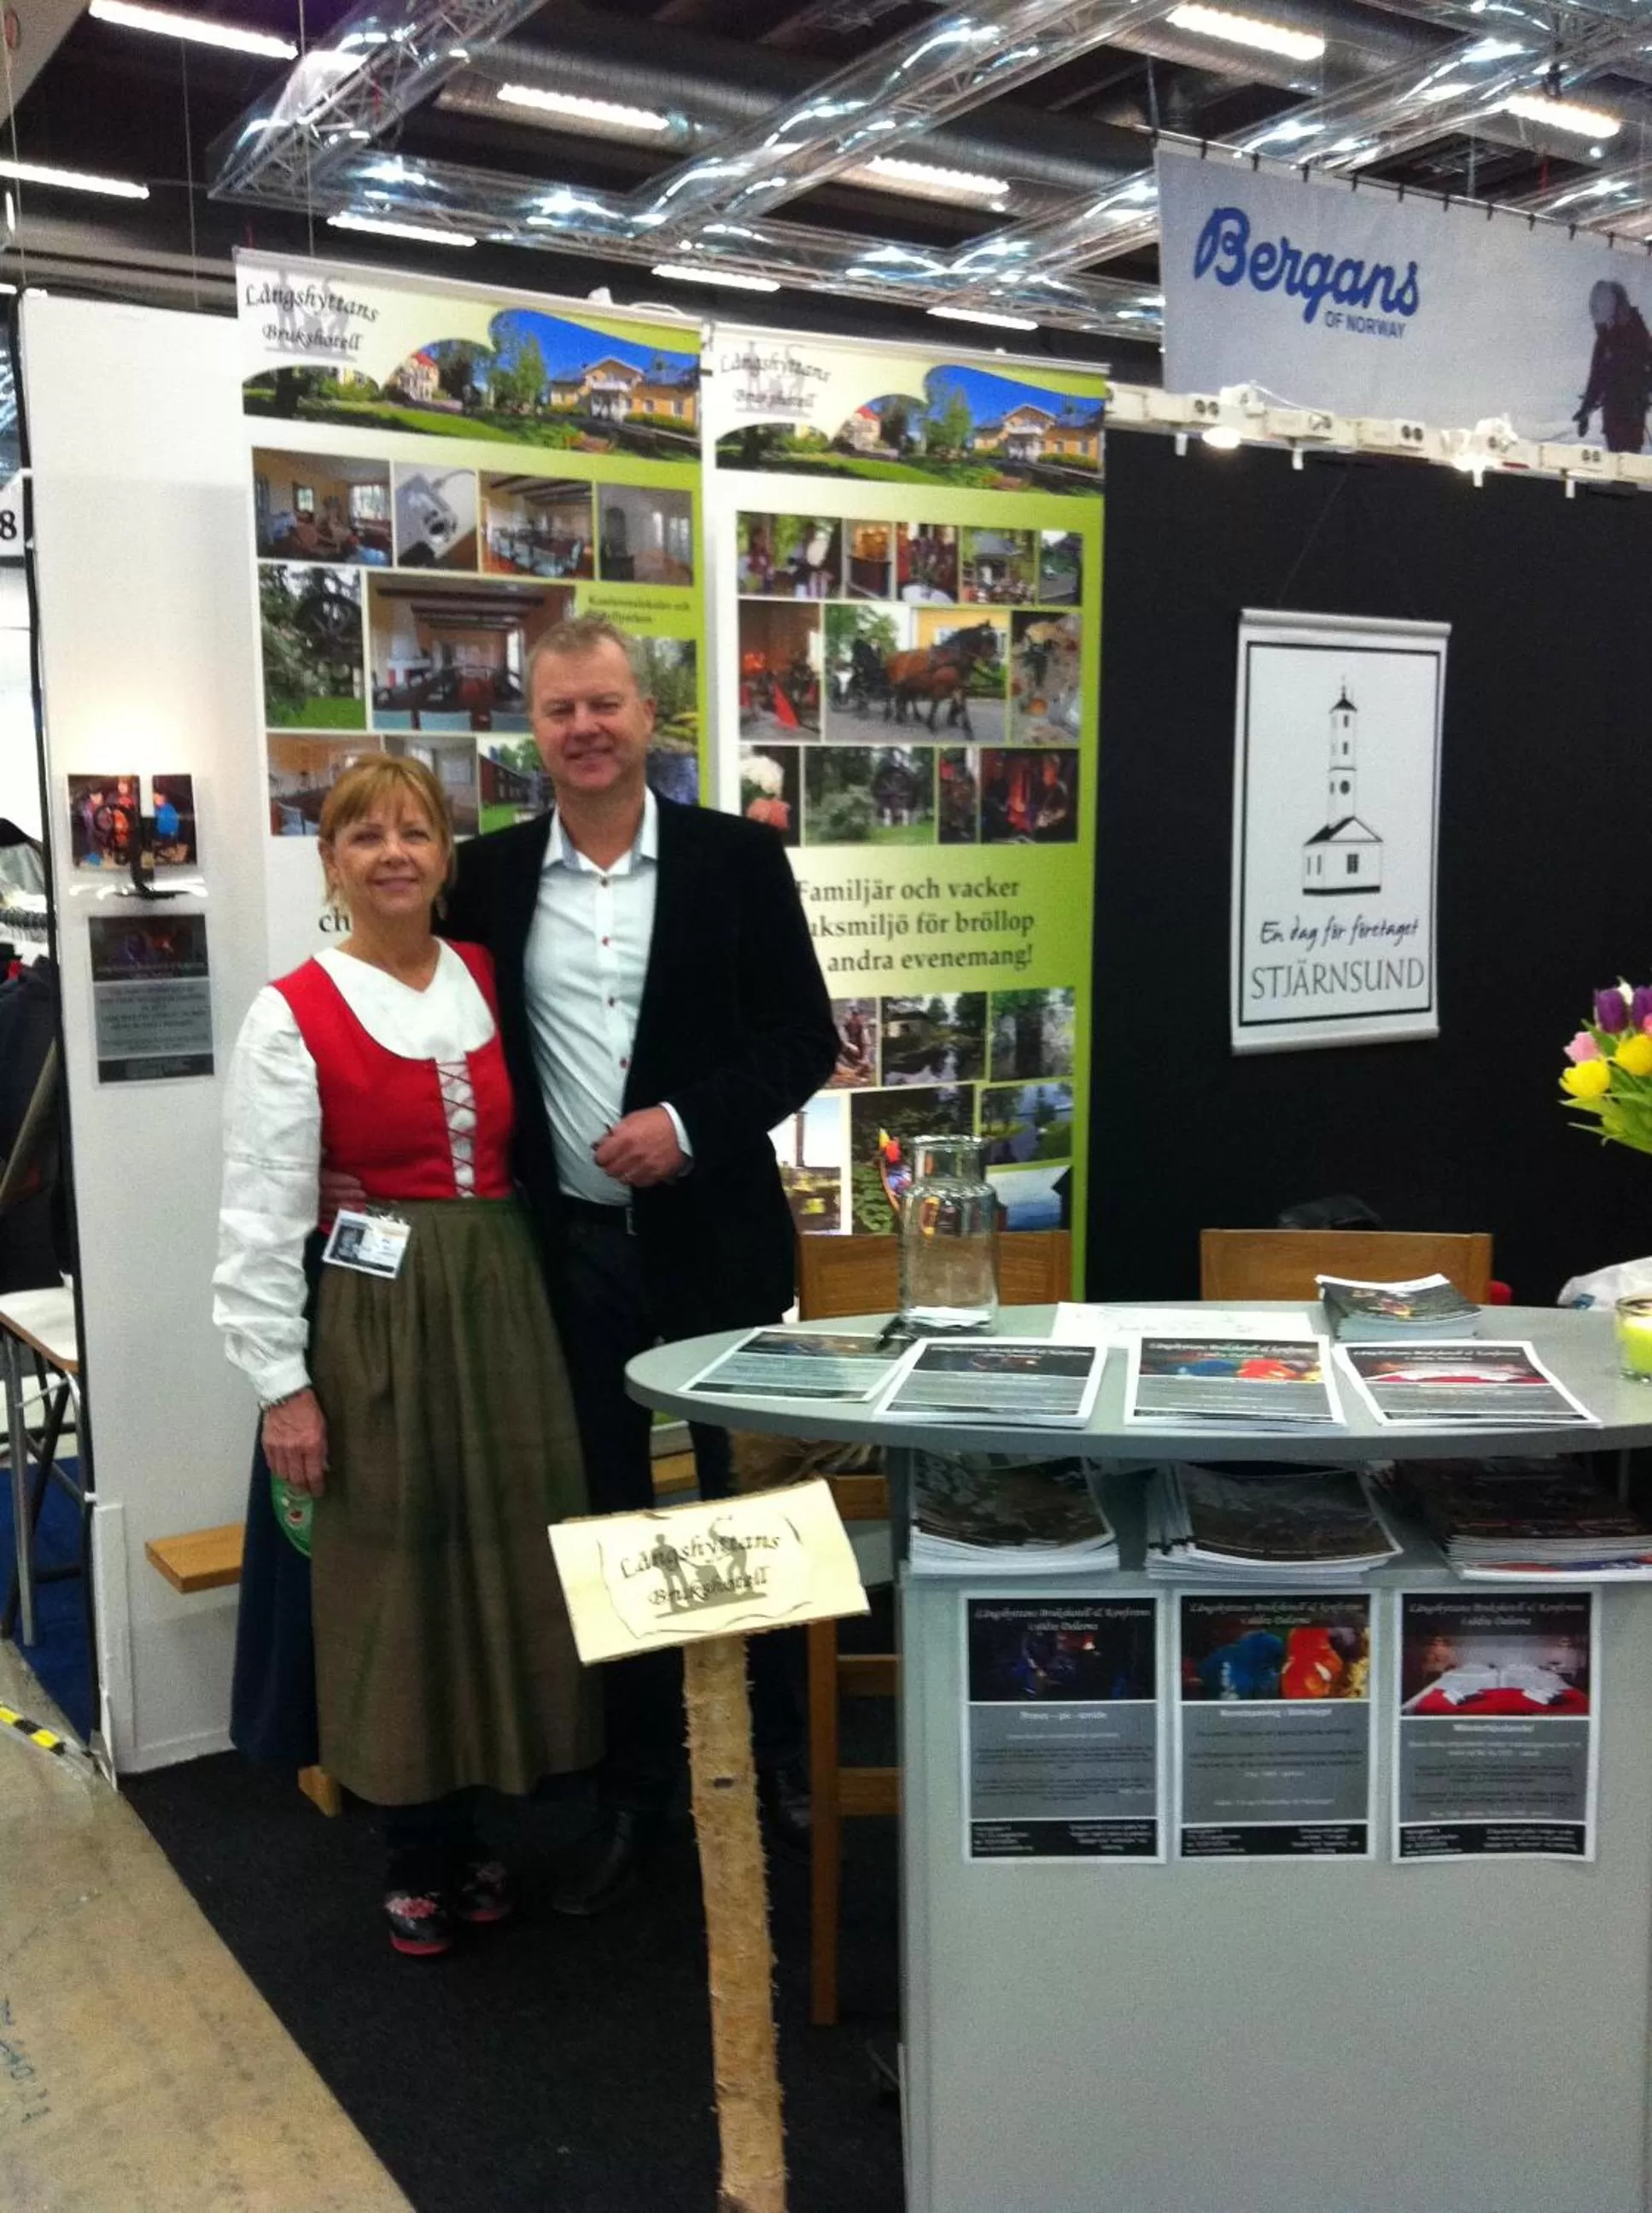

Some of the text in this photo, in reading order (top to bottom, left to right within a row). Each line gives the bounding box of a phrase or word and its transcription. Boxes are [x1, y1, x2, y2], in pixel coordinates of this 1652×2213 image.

[1194, 207, 1421, 324] Bergans
[1324, 310, 1407, 340] OF NORWAY
[901, 876, 941, 899] och
[948, 875, 1020, 897] vacker
[916, 911, 950, 933] för
[955, 909, 1036, 937] bröllop
[1260, 920, 1284, 944] En
[1290, 914, 1319, 952] dag
[1321, 914, 1346, 948] för
[827, 943, 1034, 972] andra evenemang!
[1250, 957, 1425, 1001] STJÄRNSUND
